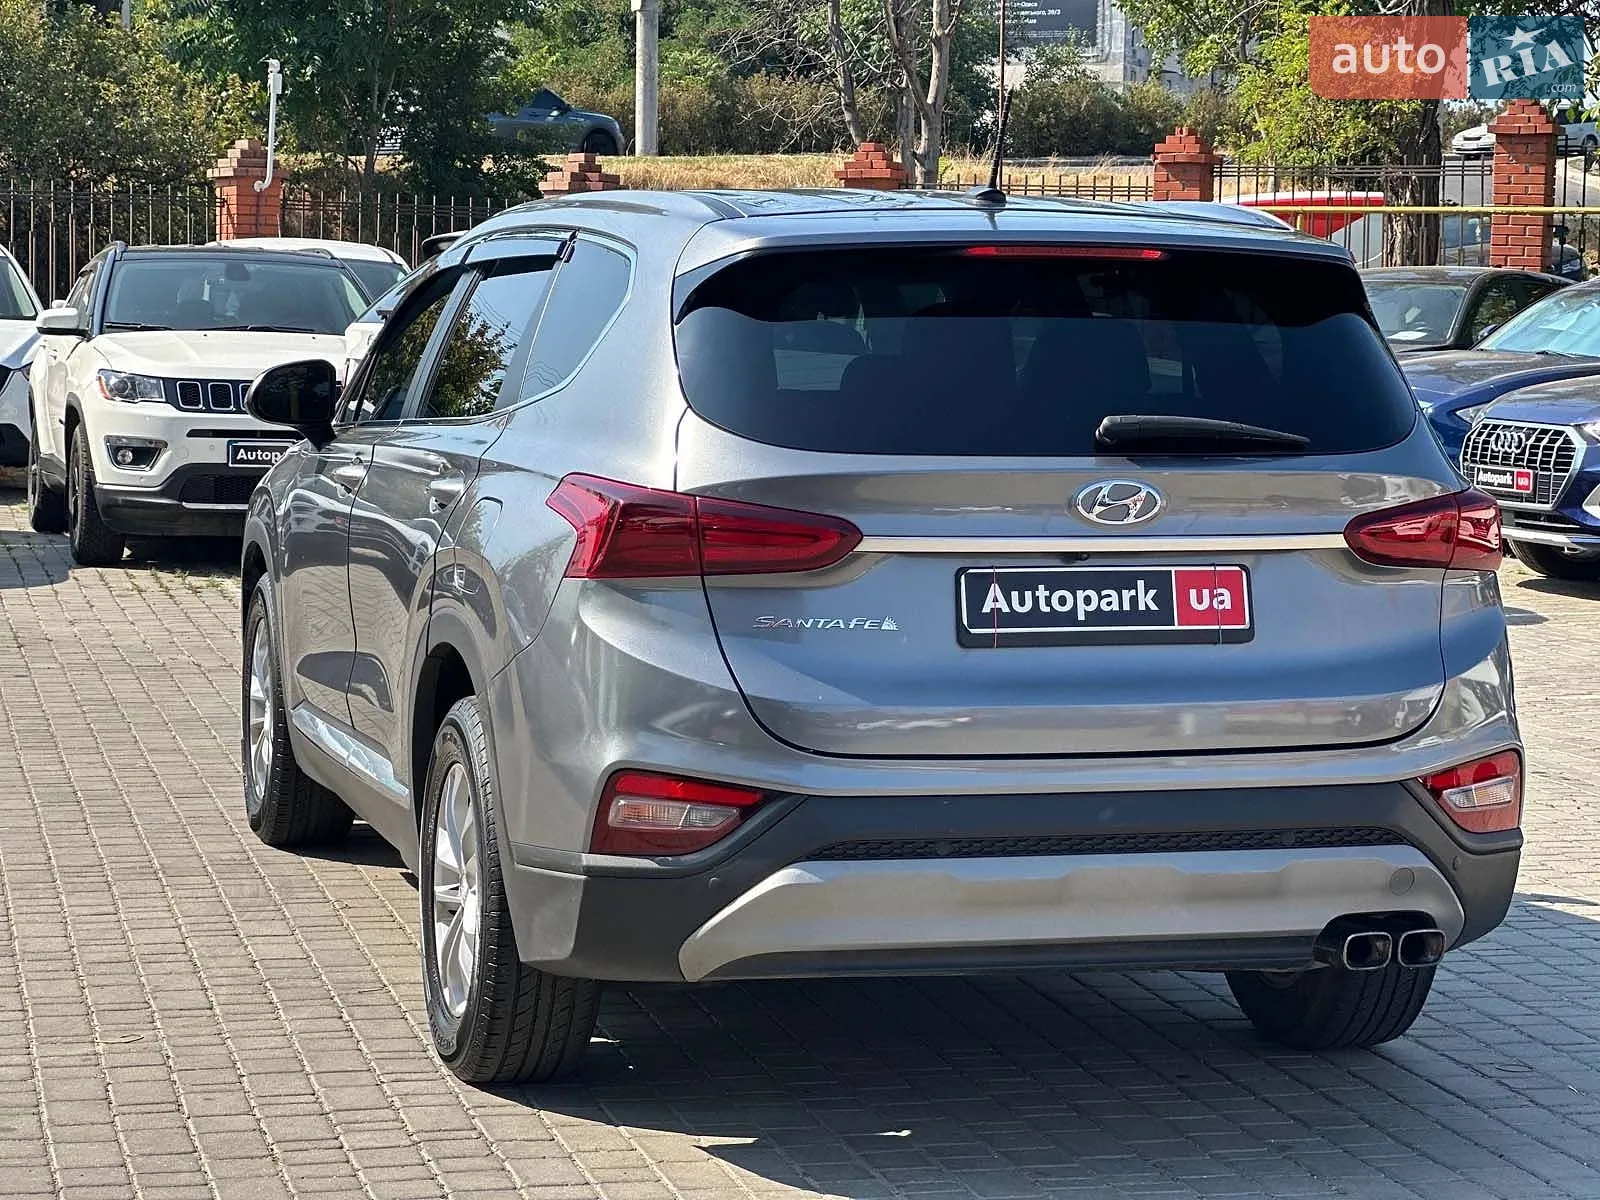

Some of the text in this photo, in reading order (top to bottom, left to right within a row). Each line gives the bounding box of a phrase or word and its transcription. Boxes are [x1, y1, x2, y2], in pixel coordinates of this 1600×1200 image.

[1478, 470, 1529, 486] Autopark ua
[982, 579, 1232, 621] Autopark ua
